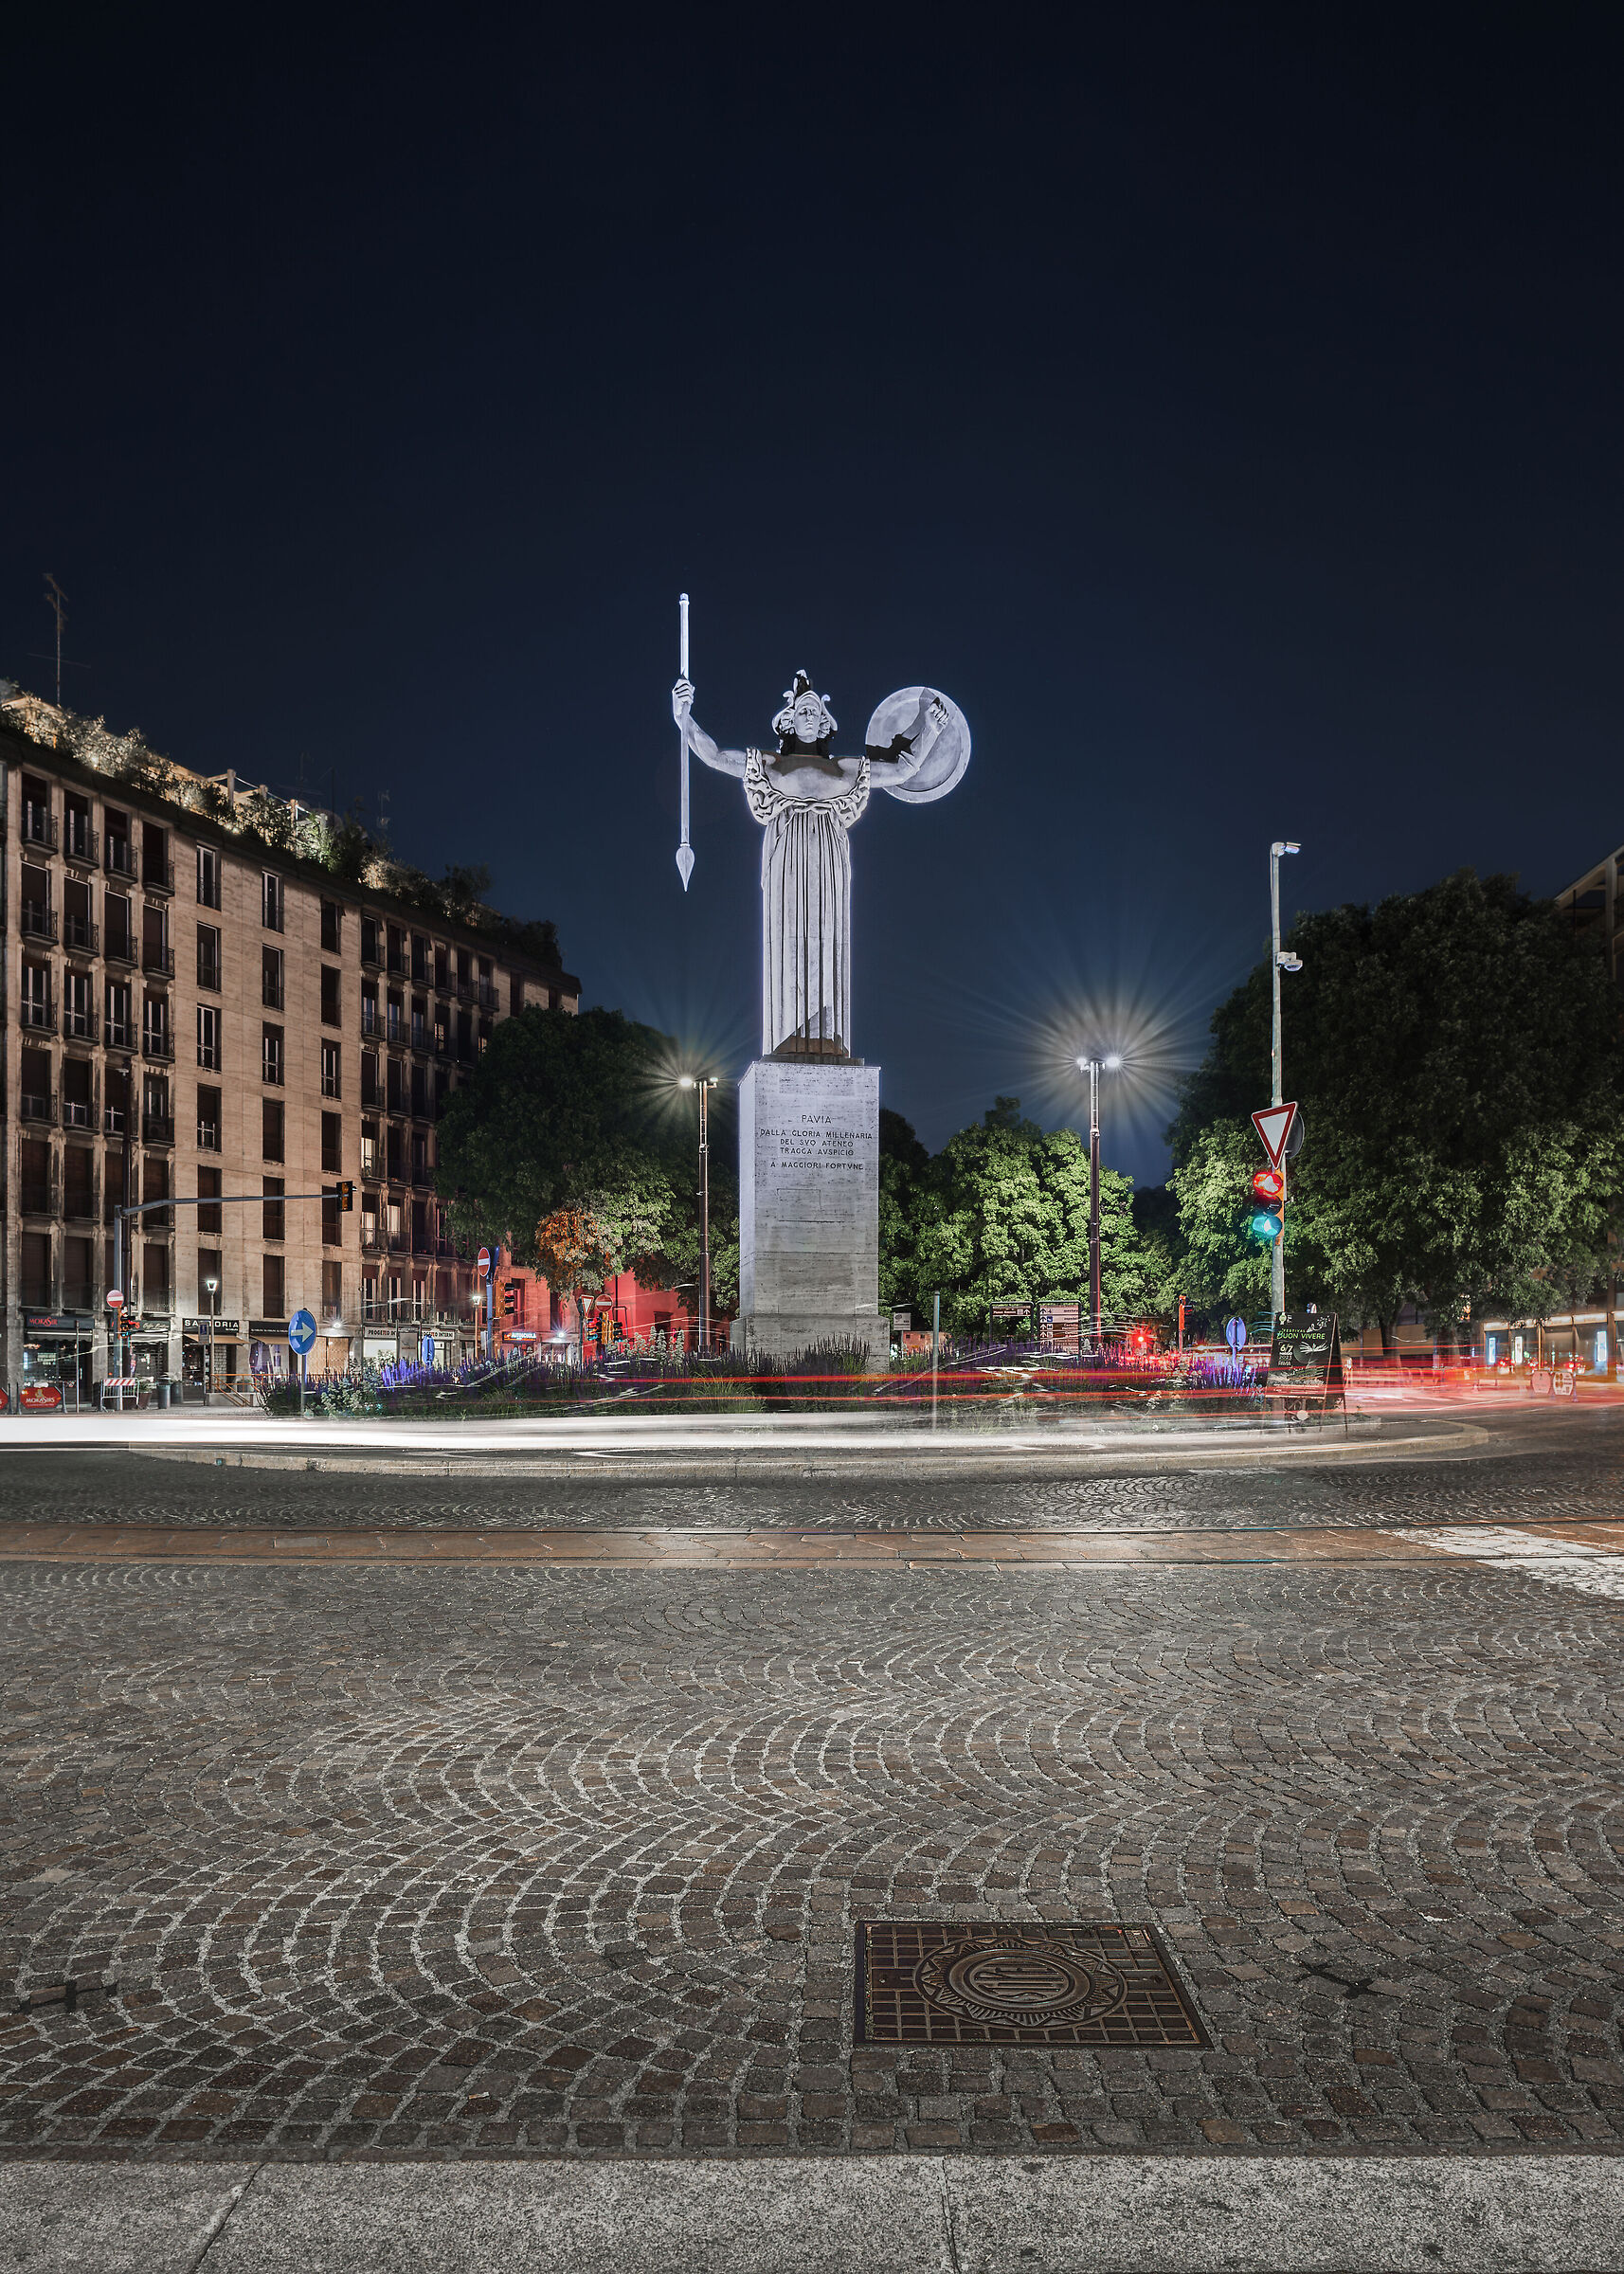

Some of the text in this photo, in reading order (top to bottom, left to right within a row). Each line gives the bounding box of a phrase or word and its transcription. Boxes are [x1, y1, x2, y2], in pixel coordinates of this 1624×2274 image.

[802, 1114, 832, 1124] PAVIA
[760, 1128, 786, 1137] DALLA
[792, 1129, 821, 1138] GLORIA
[184, 1319, 239, 1328] SATORIA
